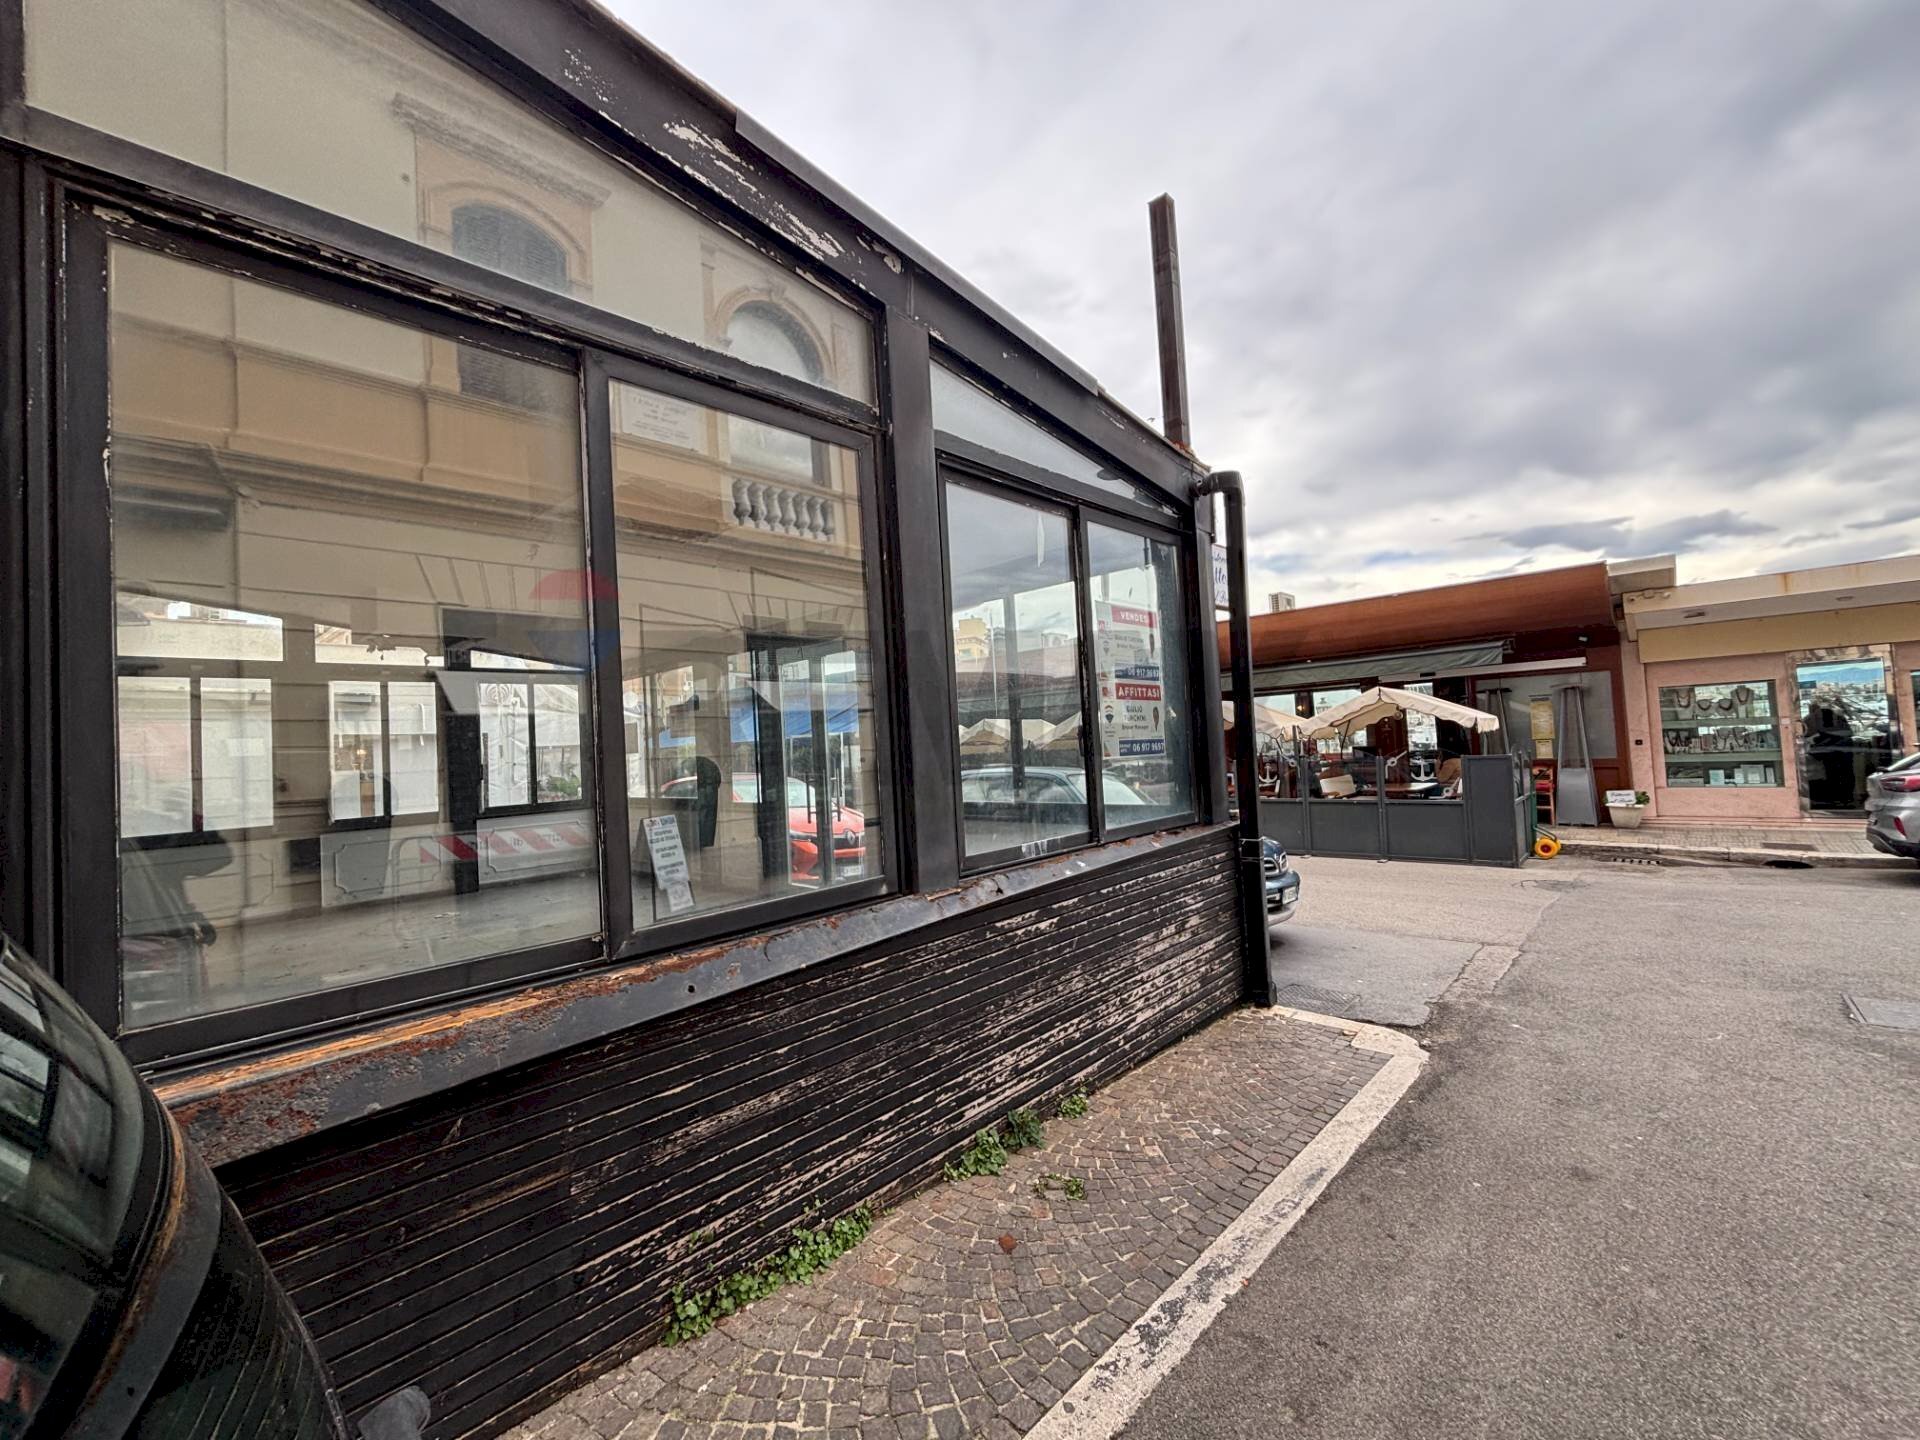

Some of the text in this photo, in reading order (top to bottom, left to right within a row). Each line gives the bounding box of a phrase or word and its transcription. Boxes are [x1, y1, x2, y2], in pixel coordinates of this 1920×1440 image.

[1118, 686, 1160, 698] AFFITTASI
[1132, 743, 1141, 752] 06
[1141, 742, 1150, 751] 917
